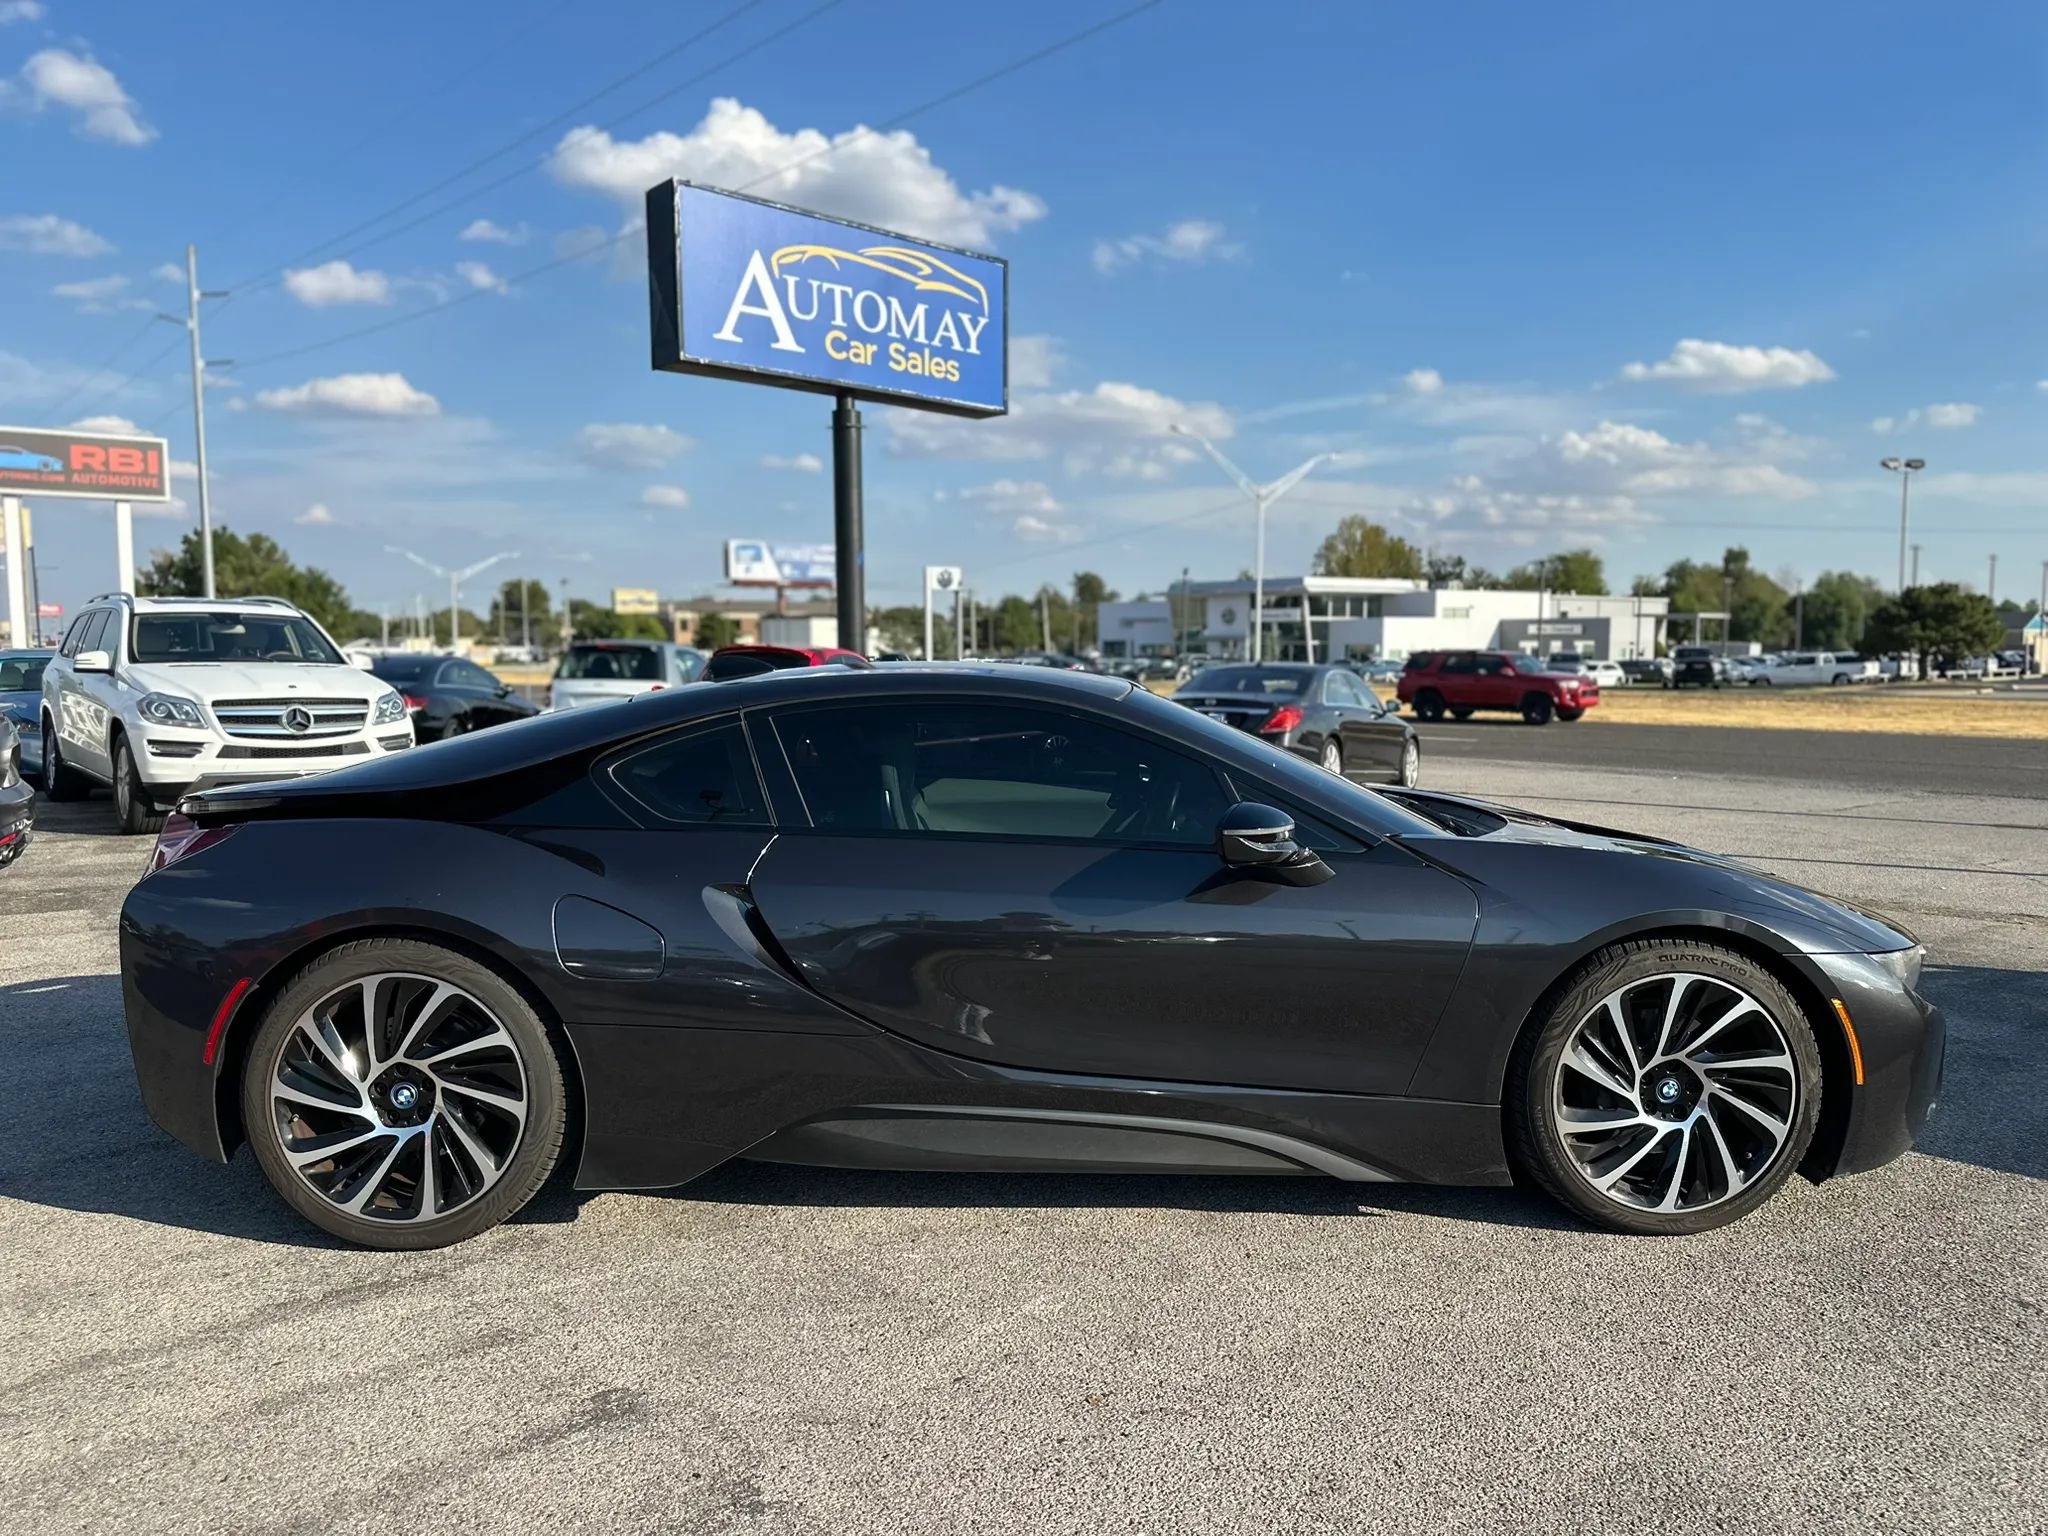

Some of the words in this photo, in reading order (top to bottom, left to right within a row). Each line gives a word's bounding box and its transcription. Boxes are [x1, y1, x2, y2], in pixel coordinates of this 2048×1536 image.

[713, 249, 989, 354] AUTOMAY
[824, 330, 877, 366] Car
[888, 342, 960, 382] Sales
[70, 444, 159, 475] RBI
[71, 473, 160, 489] AUTOMOTIVE
[1659, 954, 1719, 966] QUATRAC
[1720, 961, 1748, 977] PRO
